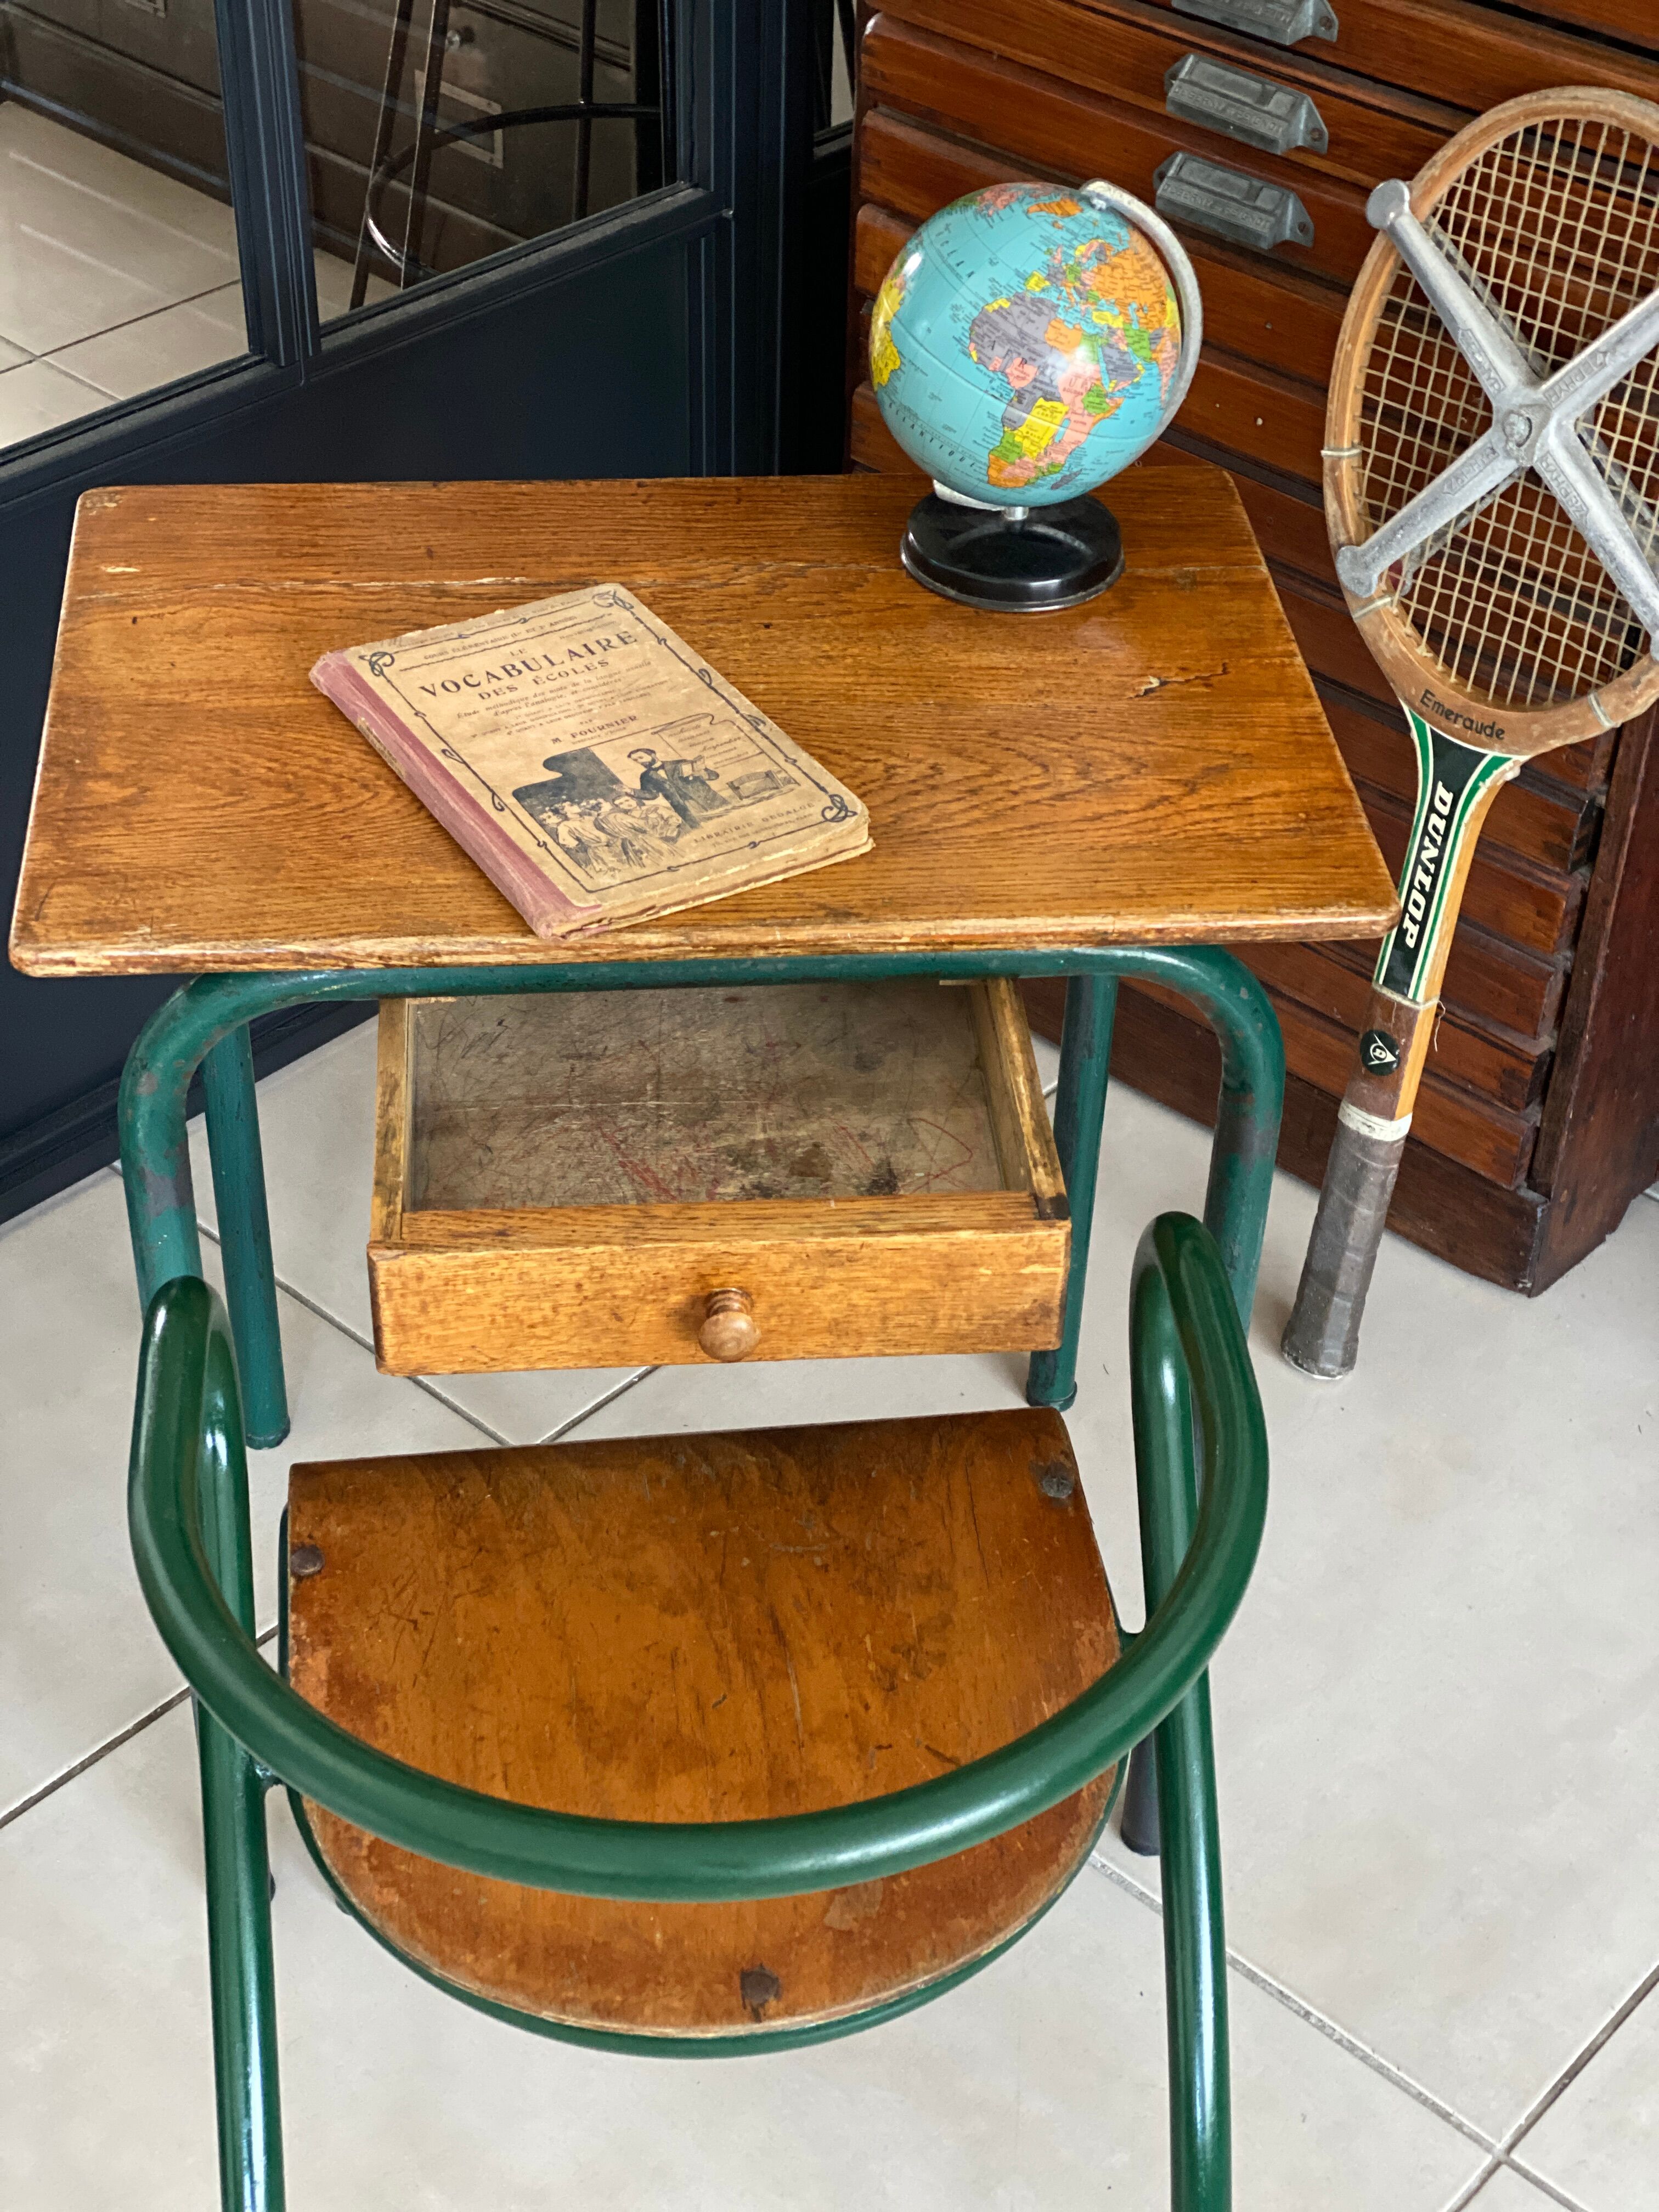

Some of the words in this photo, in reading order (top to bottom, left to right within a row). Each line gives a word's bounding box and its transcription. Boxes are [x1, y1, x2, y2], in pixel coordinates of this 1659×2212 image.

[419, 631, 636, 696] VOCABULAIRE
[509, 648, 525, 657] LE
[477, 684, 518, 700] DES
[532, 659, 609, 685] ÉCOLES
[484, 696, 529, 711] méthodique
[595, 670, 621, 681] langue
[625, 660, 651, 672] usuelle
[570, 715, 637, 738] FOURNIER
[1419, 689, 1506, 741] Emeraude
[693, 822, 753, 843] LIBRAIRIE
[1404, 780, 1454, 950] DUNLOP
